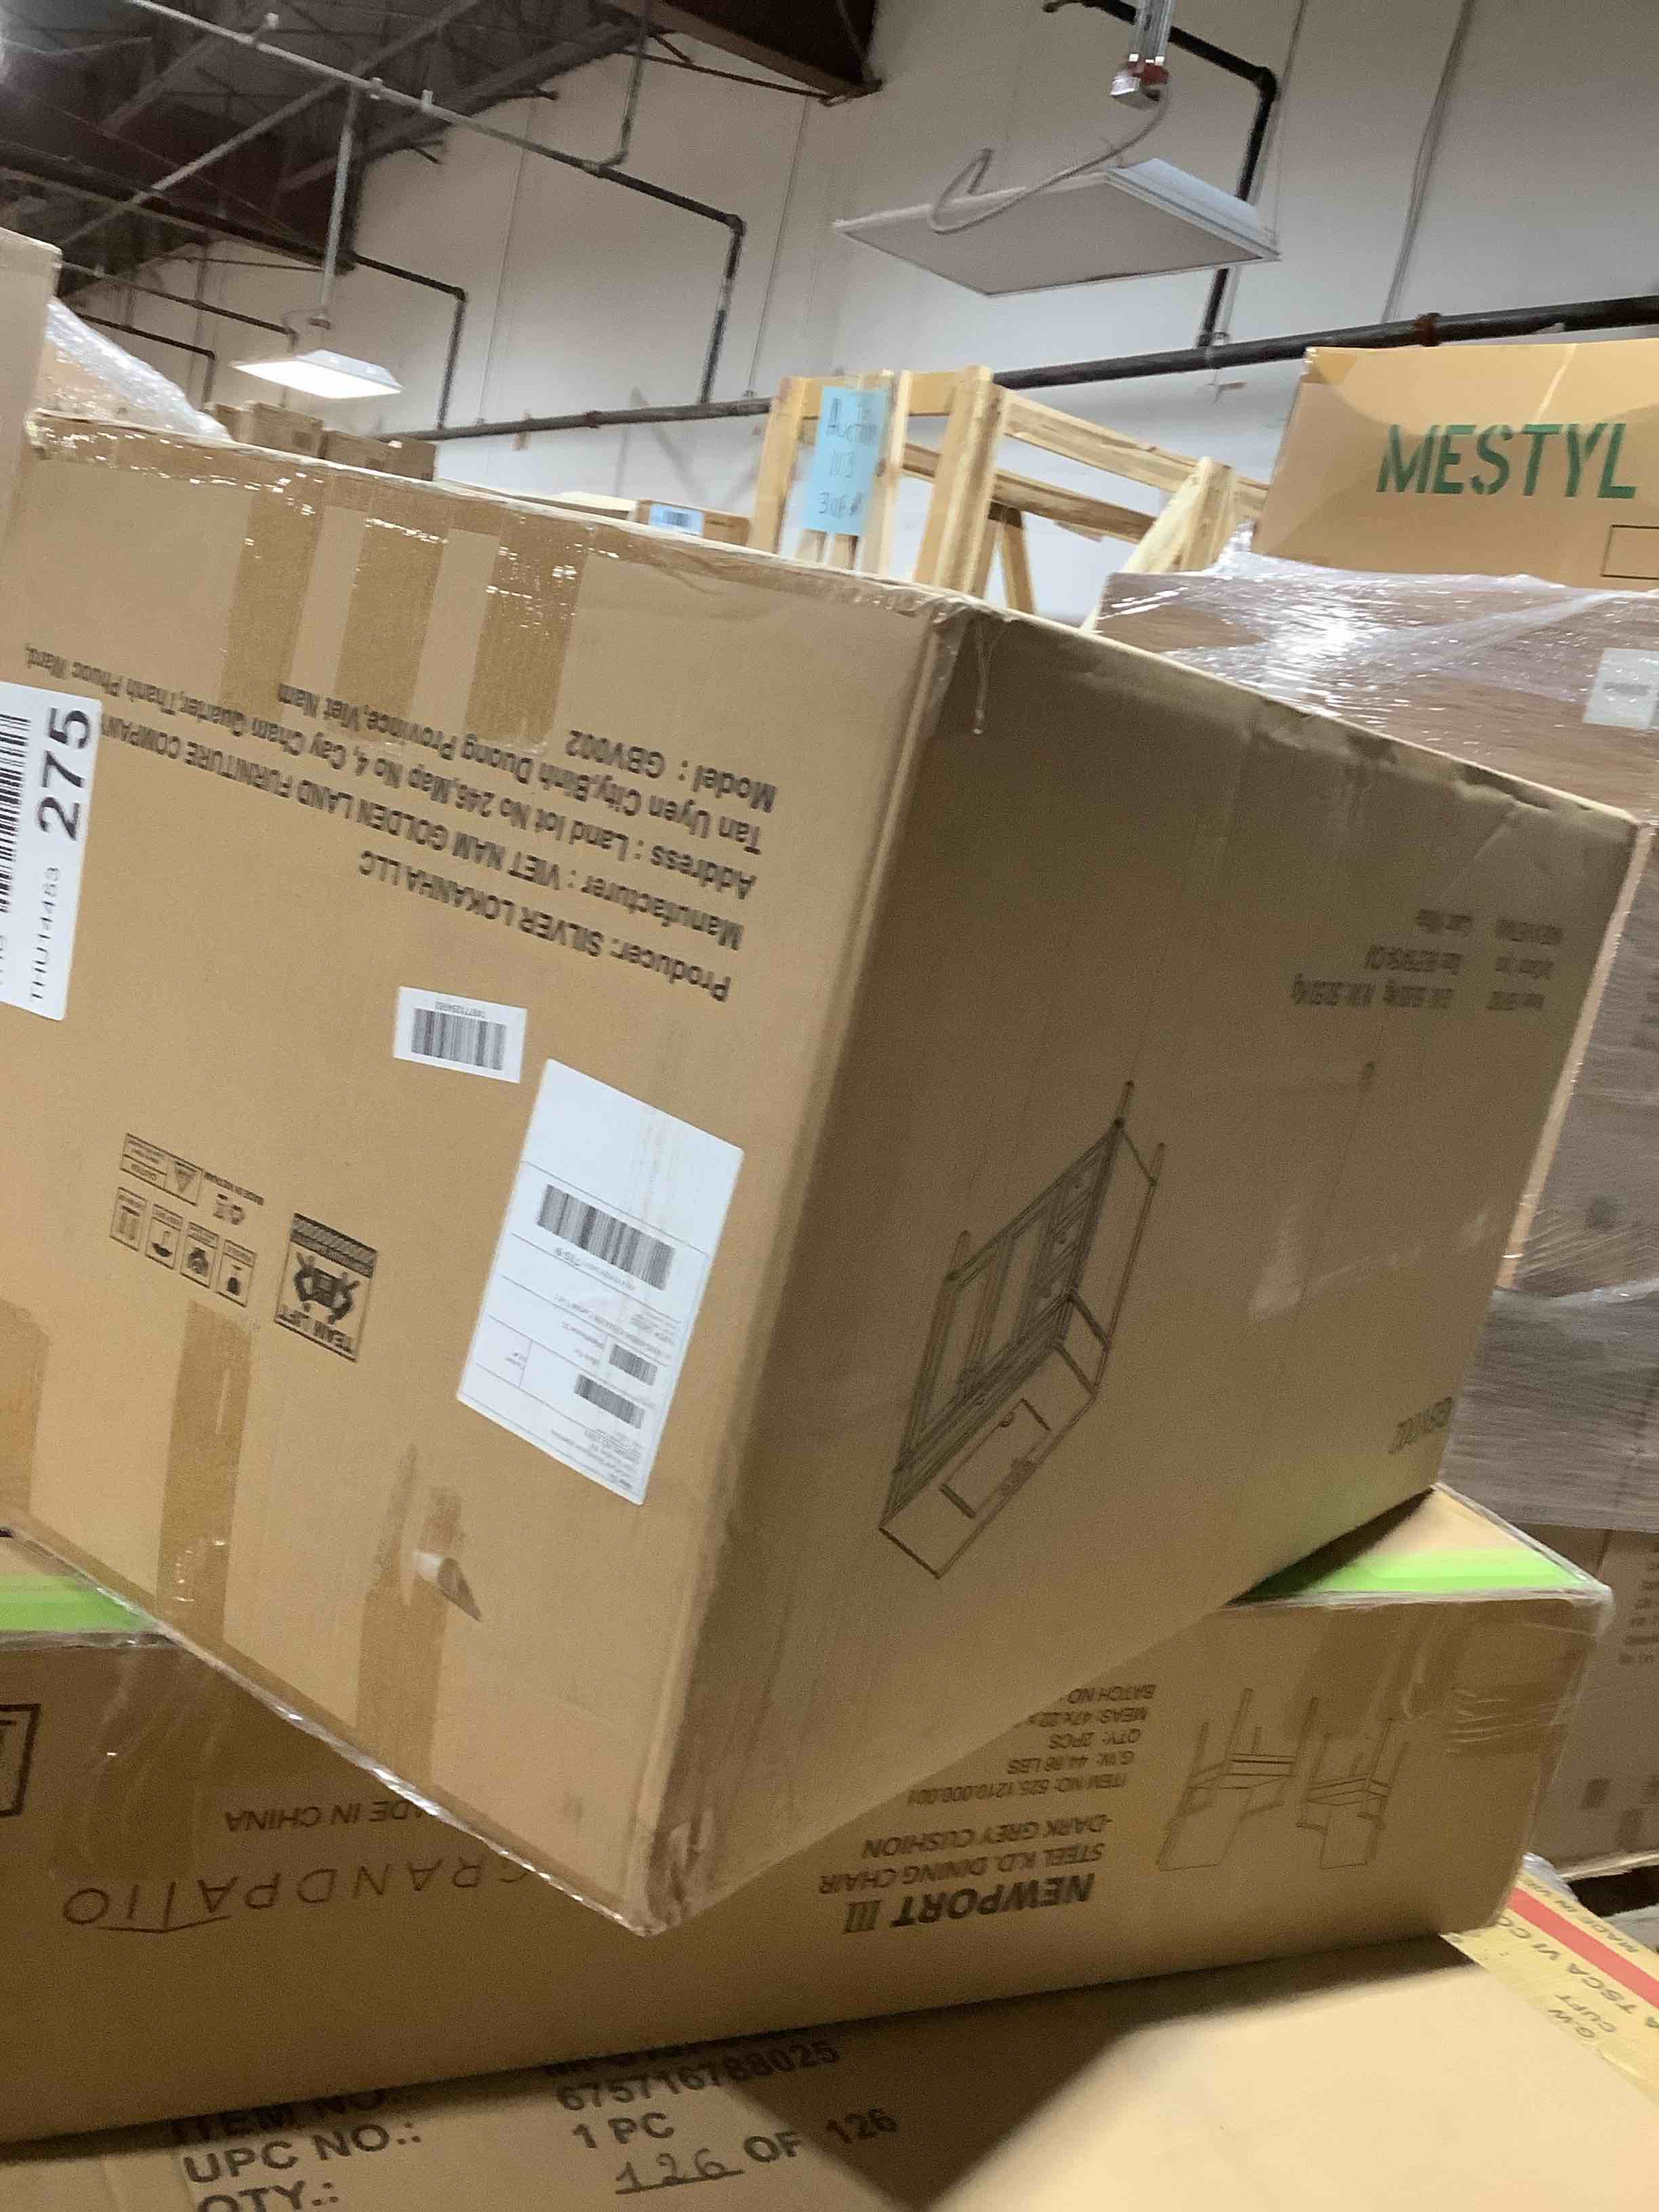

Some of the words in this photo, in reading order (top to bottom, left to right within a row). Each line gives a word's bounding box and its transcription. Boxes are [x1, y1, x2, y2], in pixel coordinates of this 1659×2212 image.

[1376, 423, 1637, 499] MESTYL
[276, 683, 320, 717] Nam
[251, 718, 305, 756] Cham
[308, 732, 346, 770] Cay
[566, 730, 665, 779] GBV002
[37, 707, 92, 840] 275
[184, 741, 293, 798] FURNITURE
[374, 758, 403, 788] No
[461, 734, 533, 785] Duong
[296, 779, 354, 819] LAND
[691, 765, 777, 813] Model
[356, 799, 449, 851] GOLDEN
[499, 798, 531, 830] No
[535, 808, 566, 841] lot
[649, 796, 711, 838] Uyen
[452, 832, 506, 871] NAM
[569, 820, 629, 861] Land
[718, 817, 762, 855] Tan
[359, 851, 401, 886] LLC
[507, 851, 560, 890] VIET
[650, 845, 758, 900] Address
[518, 907, 605, 957] SILVER
[580, 876, 744, 951] Manufacturer
[609, 938, 731, 1002] Producer:
[224, 1807, 323, 1832] CHINA
[330, 1803, 361, 1826] IN
[981, 1822, 1038, 1844] GREY
[862, 1829, 975, 1859] CUSHION
[1043, 1843, 1105, 1868] STEEL
[819, 1868, 897, 1895] CHAIR
[902, 1857, 989, 1884] DINING
[843, 1900, 882, 1935] III
[889, 1873, 1095, 1928] NEWPORT
[1567, 1963, 1638, 2015] TSCA
[573, 2123, 598, 2148] 1
[609, 2111, 674, 2144] PC
[743, 2130, 804, 2163] OF
[825, 2108, 899, 2146] 126
[183, 2140, 299, 2184] UPC
[311, 2122, 422, 2161] NO.:
